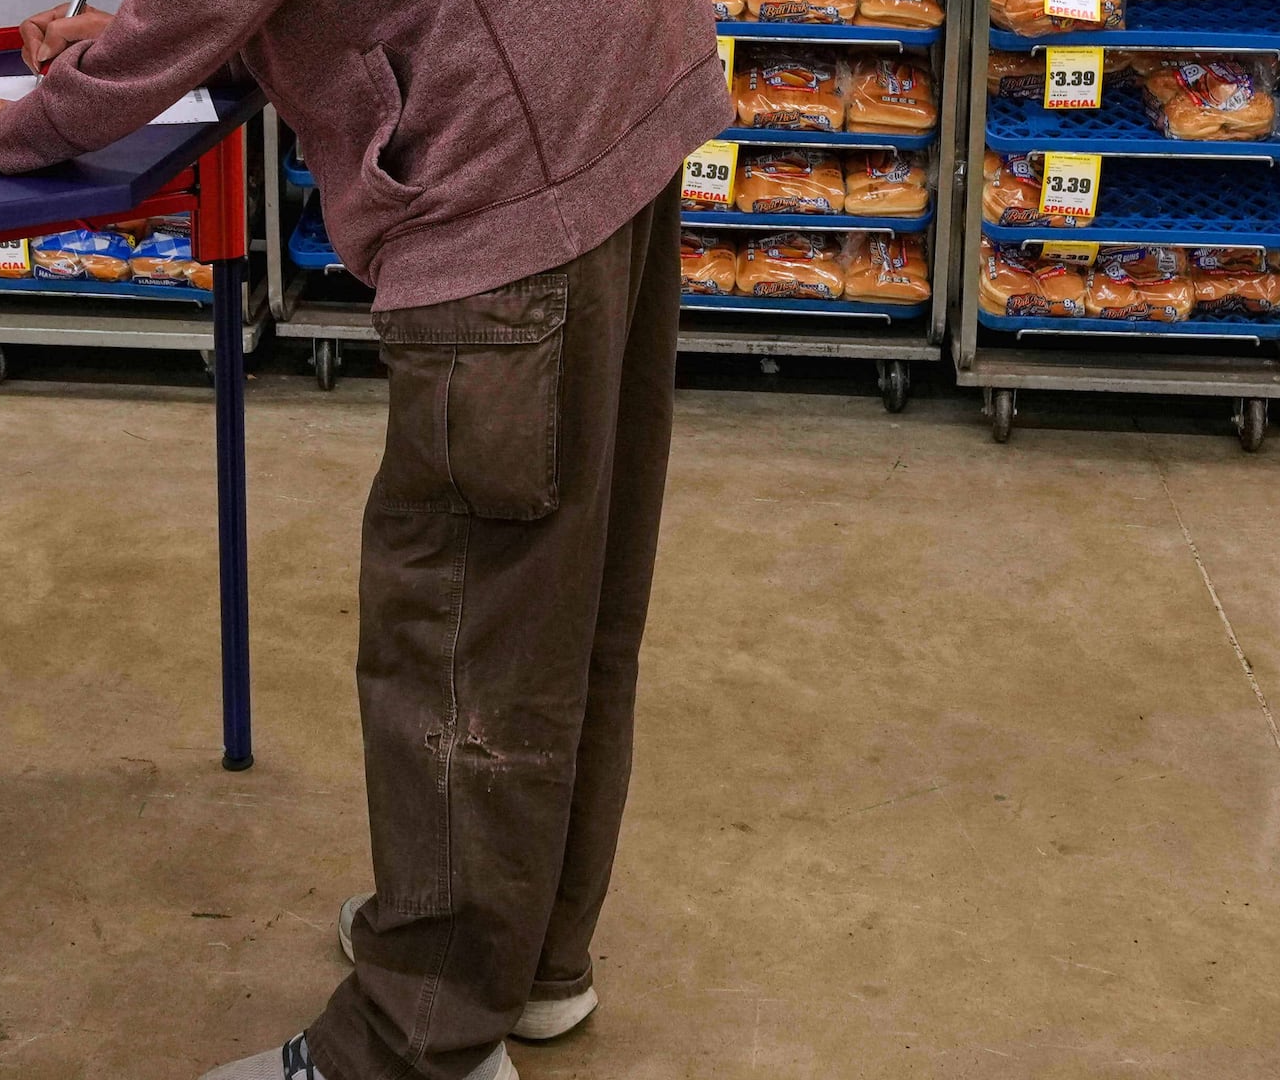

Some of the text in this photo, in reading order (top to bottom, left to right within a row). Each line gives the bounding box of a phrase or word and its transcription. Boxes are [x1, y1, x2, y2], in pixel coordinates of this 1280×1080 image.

[1049, 5, 1097, 20] SPECIAL
[1049, 70, 1095, 87] $3.39
[1048, 99, 1097, 108] SPECIAL
[686, 161, 729, 181] $3.39
[1046, 176, 1091, 194] $3.39
[682, 189, 728, 202] SPECIAL
[1043, 205, 1091, 216] SPECIAL
